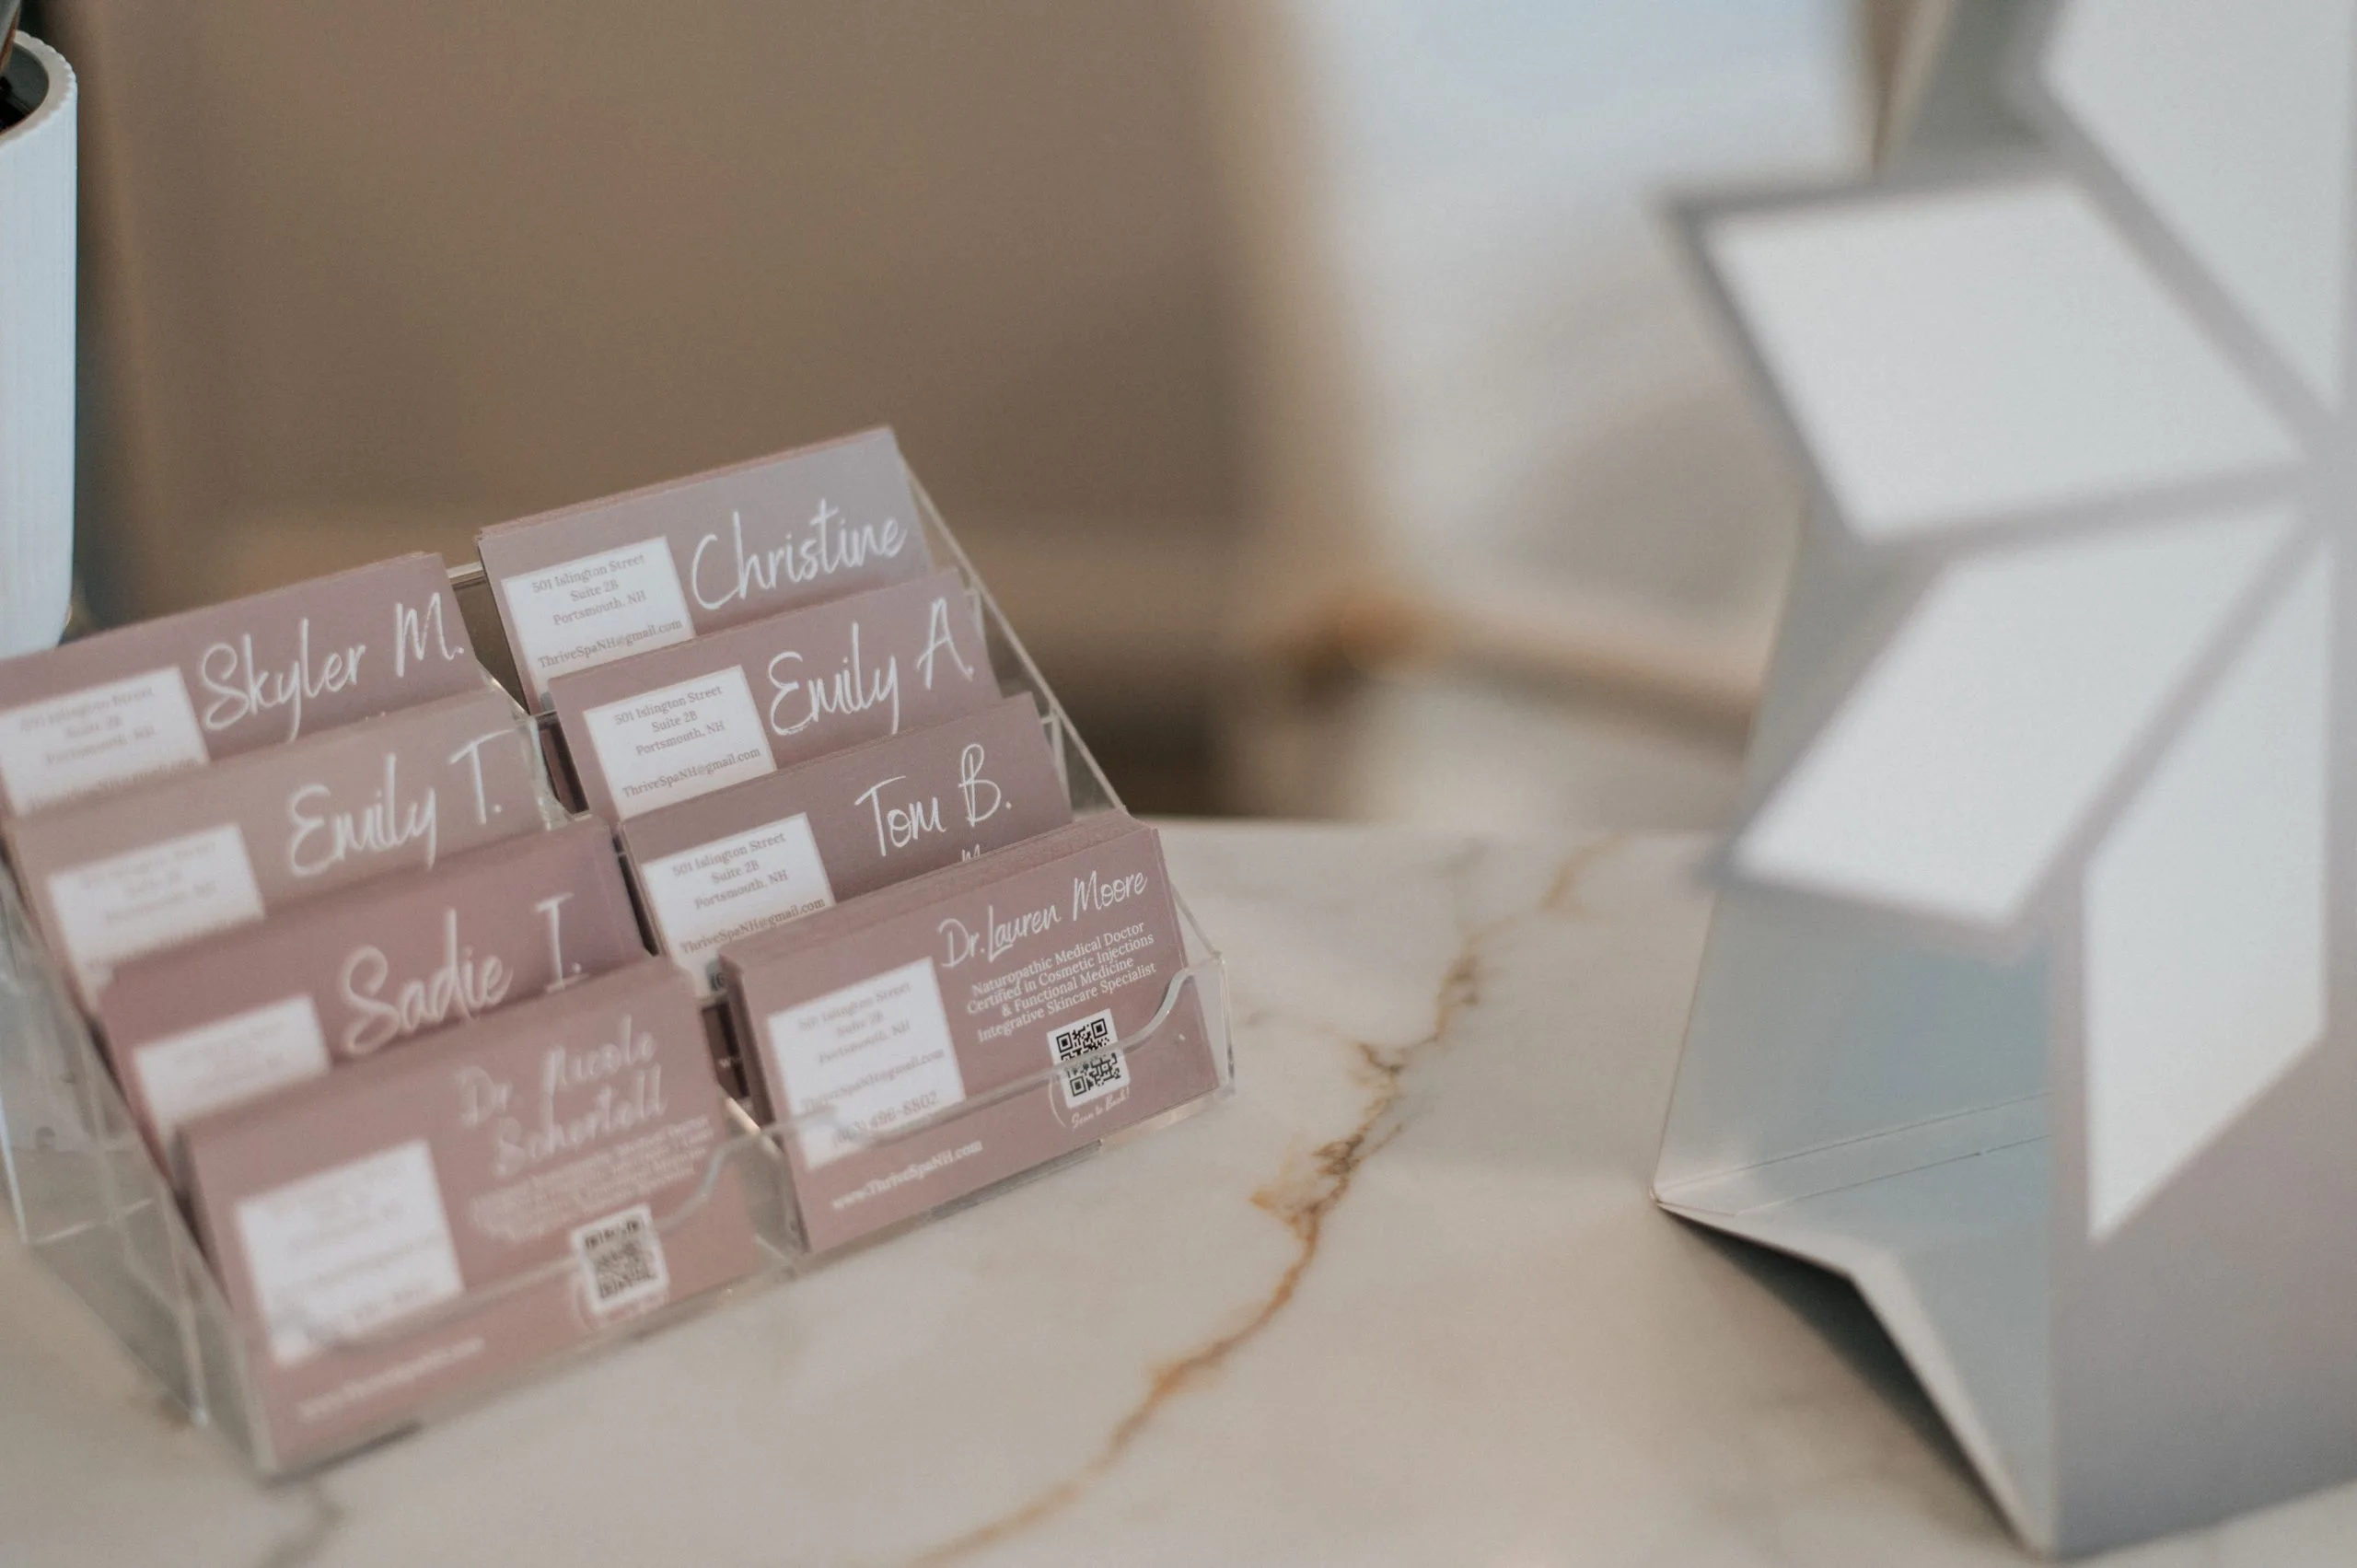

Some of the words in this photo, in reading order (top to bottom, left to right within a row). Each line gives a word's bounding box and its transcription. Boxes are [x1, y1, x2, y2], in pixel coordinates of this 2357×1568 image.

[532, 581, 552, 594] 501
[555, 565, 608, 587] Islington
[610, 553, 645, 573] Street
[692, 498, 908, 610] Christine
[553, 598, 626, 626] Portsmouth,
[628, 590, 647, 604] NH
[570, 587, 602, 602] Suite
[604, 579, 620, 592] 2B
[198, 617, 367, 744] Skyler
[395, 592, 465, 678] M.
[538, 618, 683, 669] ThriveSpaNH@gmail.com
[768, 621, 900, 736] Emily
[916, 597, 976, 689] A.
[614, 713, 635, 726] 501
[636, 697, 687, 718] Islington
[688, 685, 723, 703] Street
[652, 716, 681, 733] Suite
[683, 710, 699, 723] 2B
[635, 727, 706, 756] Portsmouth,
[707, 720, 726, 733] NH
[622, 747, 761, 798] ThriveSpaNH@gmail.com
[286, 751, 438, 872] Emily
[447, 727, 516, 825] T.
[853, 775, 946, 857] Tom
[958, 743, 1012, 827] B.
[672, 863, 693, 877] 501
[695, 845, 748, 868] Islington
[749, 833, 786, 852] Street
[711, 867, 742, 884] Suite
[744, 859, 760, 873] 2B
[695, 877, 767, 910] Portsmouth,
[769, 869, 789, 883] NH
[1073, 870, 1148, 922] Moore
[679, 897, 826, 955] ThriveSpaNH@gmail.com
[340, 908, 515, 1055] Sadie
[967, 987, 1022, 1015] Certified
[1025, 979, 1037, 994] in
[1039, 957, 1095, 986] Cosmetic
[1097, 934, 1155, 965] Injections
[972, 958, 1052, 996] Naturopathic
[1055, 936, 1102, 965] Medical
[1104, 922, 1145, 946] Doctor
[977, 1007, 1046, 1042] Integrative
[1048, 987, 1098, 1015] Skincare
[1100, 962, 1157, 995] Specialist
[1002, 1004, 1012, 1017] &
[1015, 979, 1078, 1011] Functional
[1080, 958, 1134, 985] Medicine
